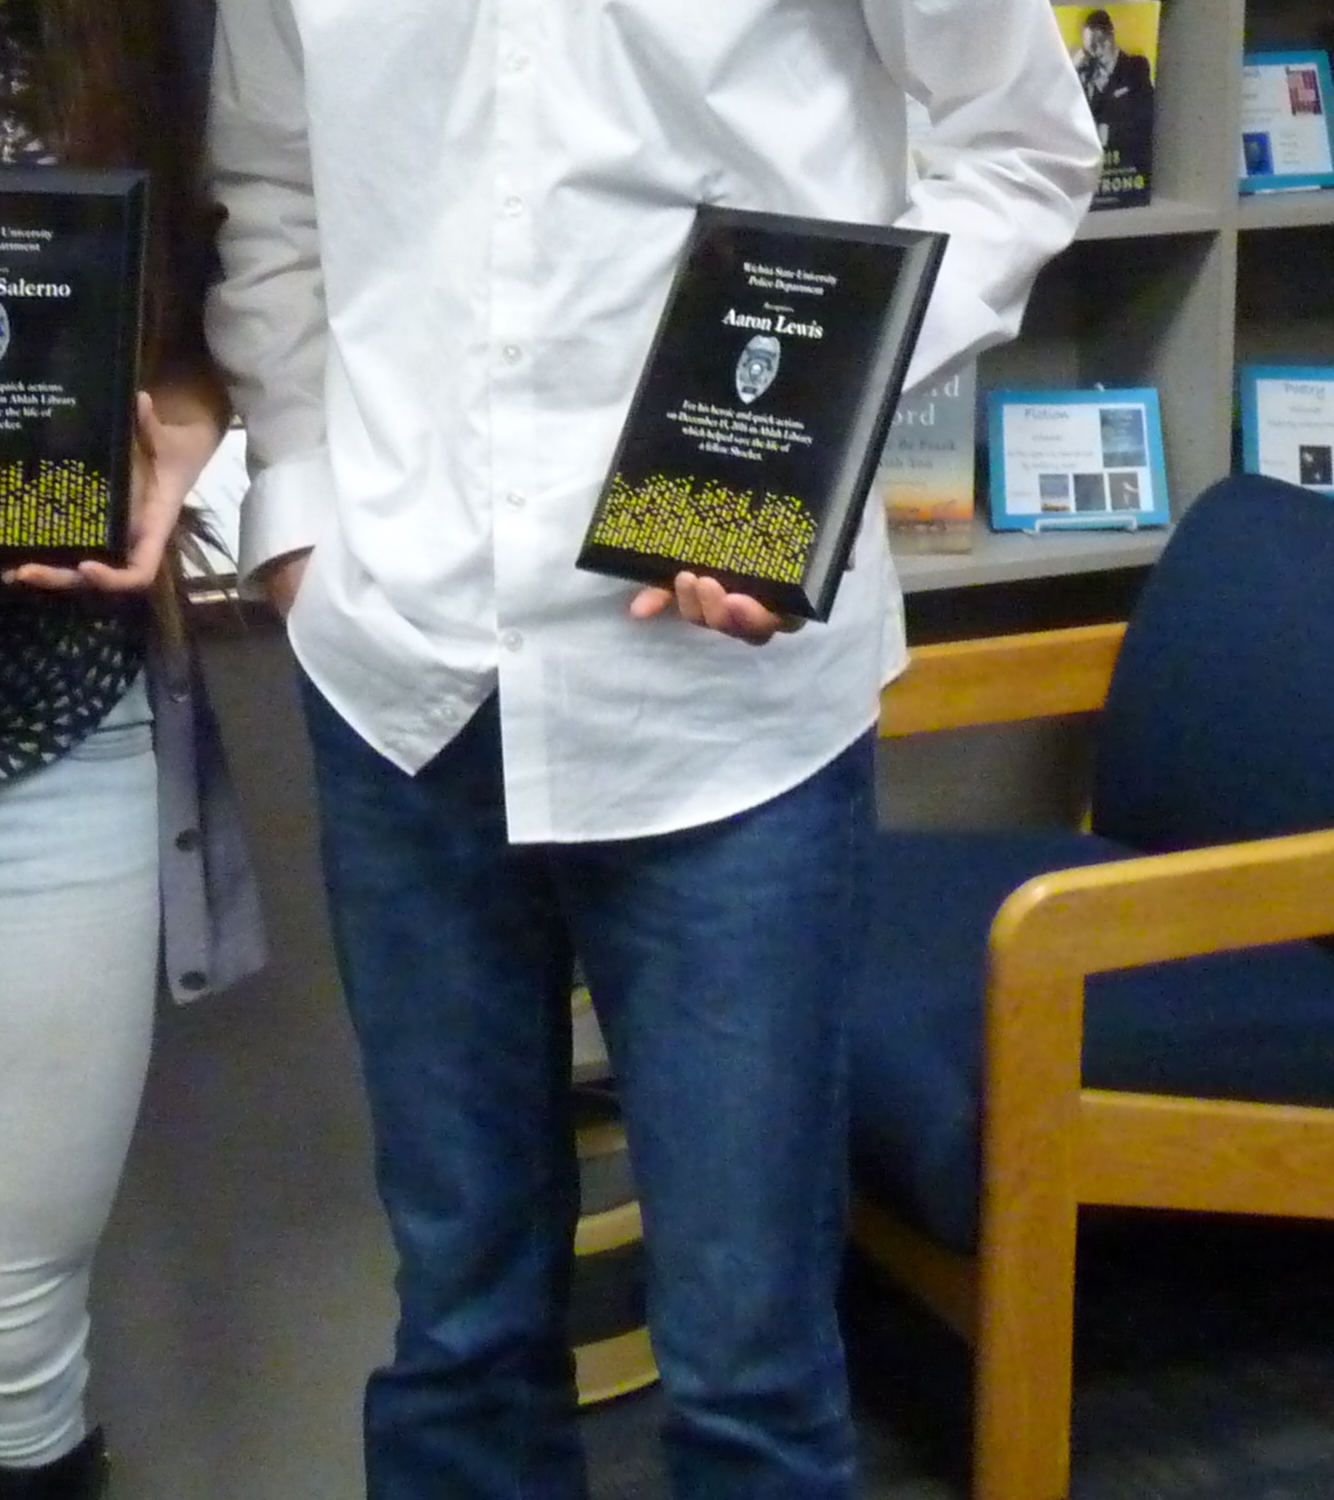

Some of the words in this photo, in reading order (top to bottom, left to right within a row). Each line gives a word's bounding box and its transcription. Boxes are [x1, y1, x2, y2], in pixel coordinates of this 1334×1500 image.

[1, 226, 53, 241] University
[721, 308, 772, 331] Aaron
[774, 314, 824, 340] Lewis
[27, 383, 63, 392] actions
[41, 395, 76, 407] Library
[5, 407, 21, 417] the
